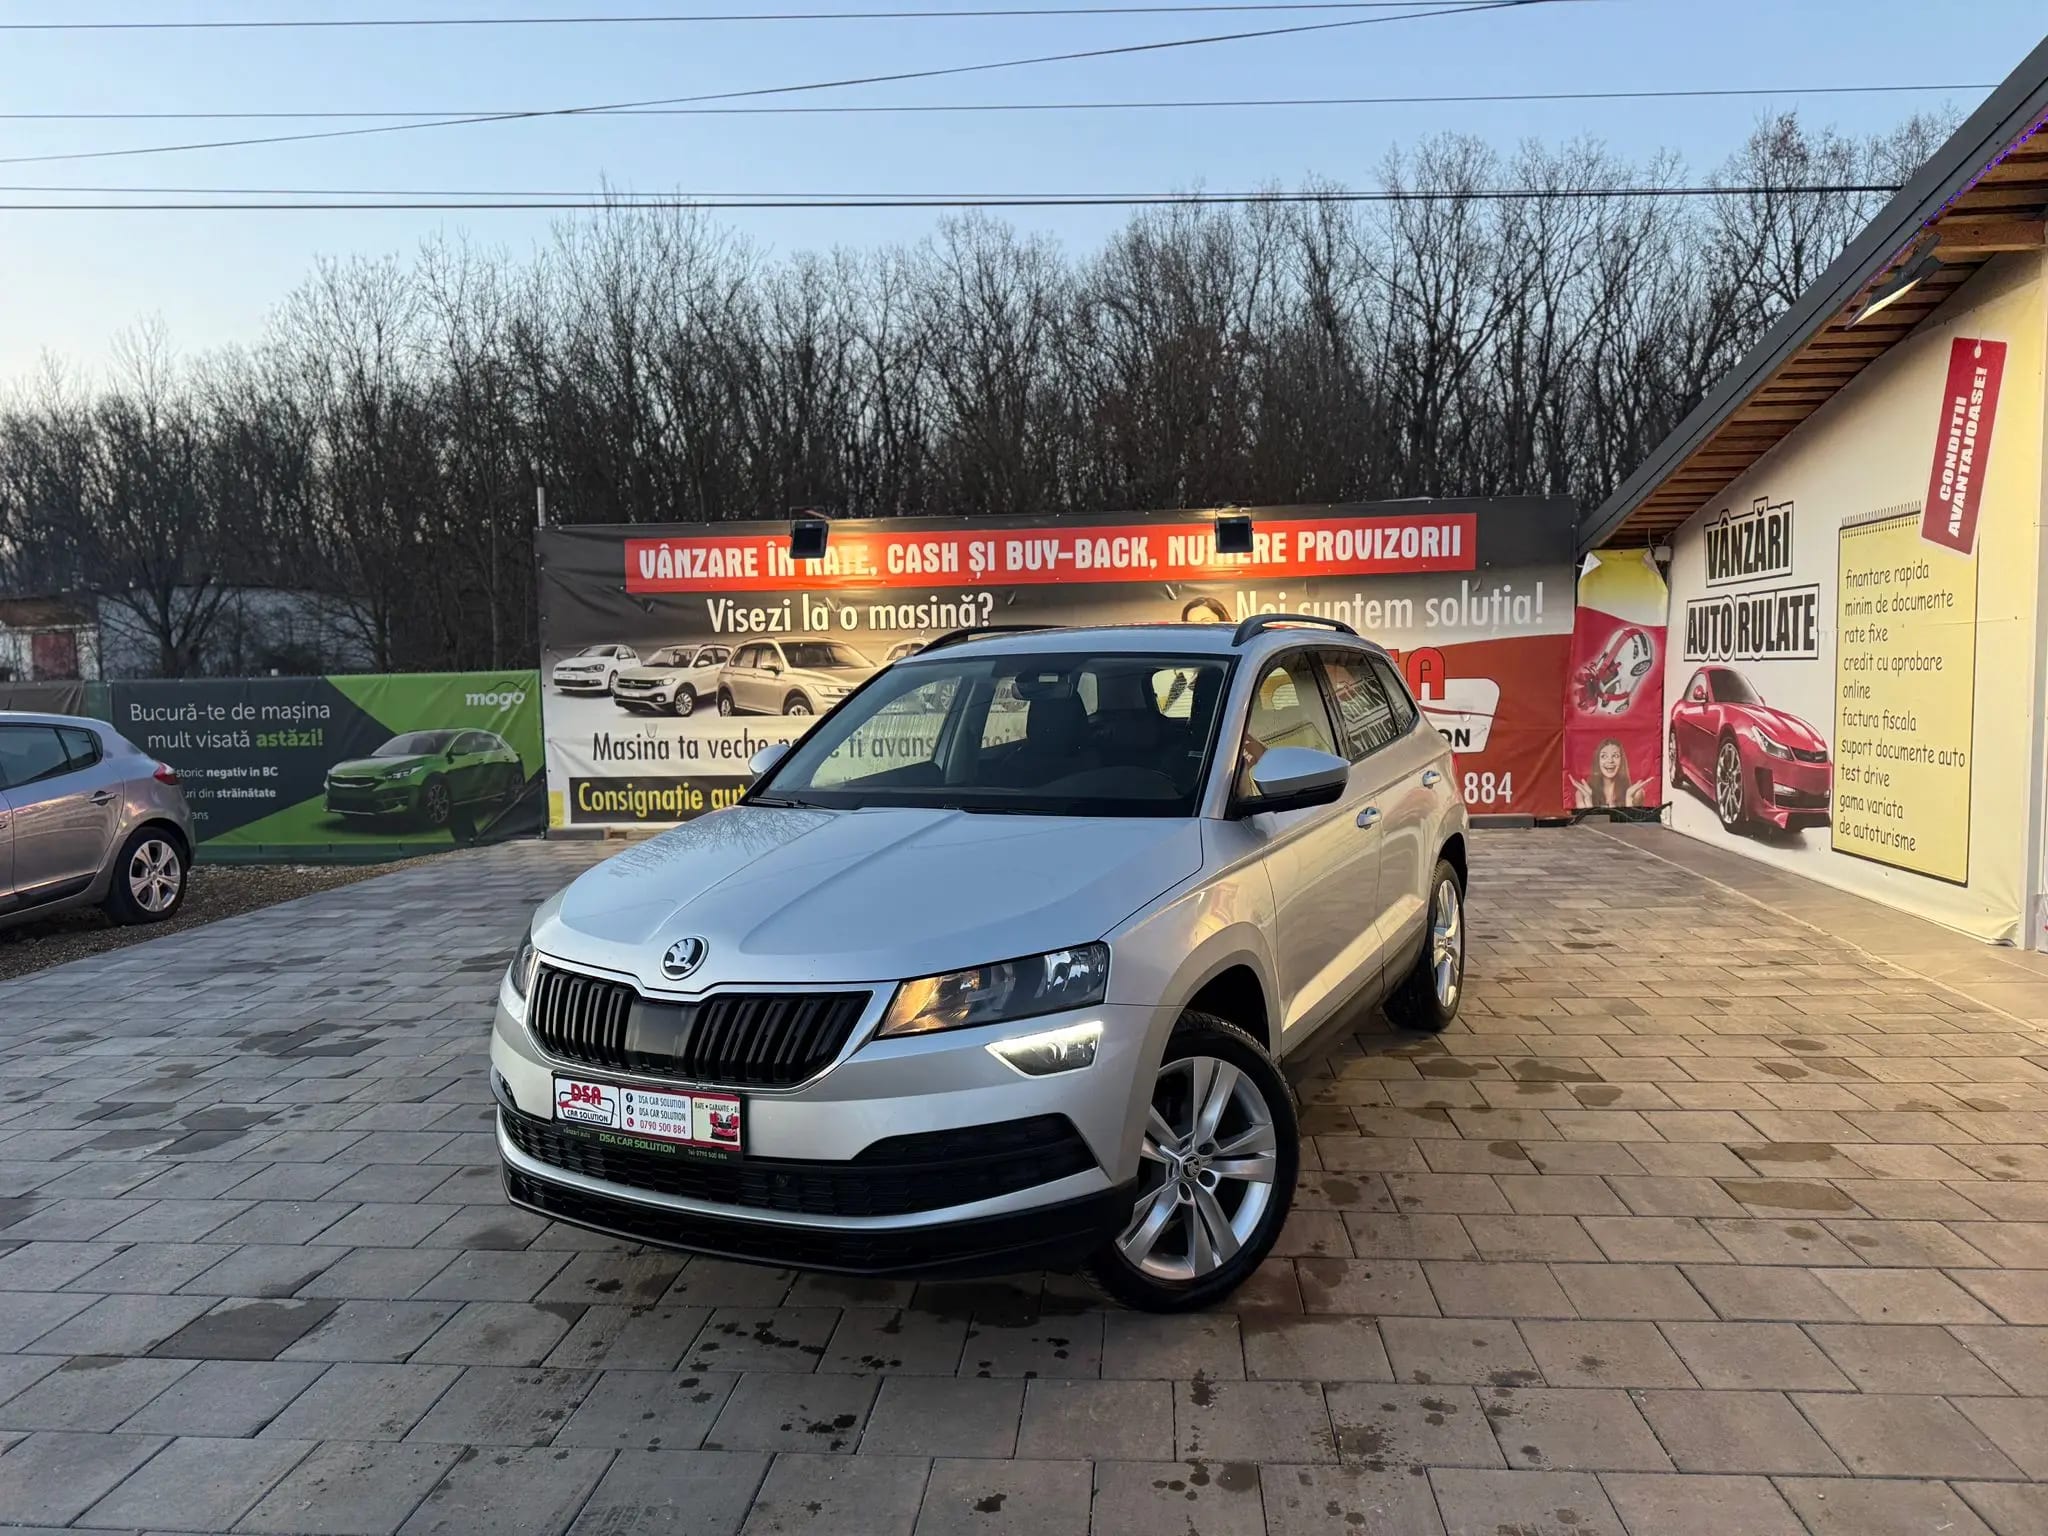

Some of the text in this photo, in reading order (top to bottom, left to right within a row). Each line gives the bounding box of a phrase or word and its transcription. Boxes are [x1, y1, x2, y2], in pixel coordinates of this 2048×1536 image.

[1939, 396, 1967, 501] CONDITII
[1948, 367, 1988, 538] AVANTAJOASE!
[639, 543, 759, 579] VÂNZARE
[887, 542, 958, 574] CASH
[968, 541, 995, 579] ȘI
[1006, 536, 1158, 571] BUY-BACK,
[1298, 525, 1461, 562] PROVIZORII
[1707, 505, 1790, 580] VÂNZĂRI
[1846, 558, 1929, 589] finantare rapida
[706, 598, 791, 633] Visezi
[802, 593, 829, 632] la
[840, 605, 858, 631] o
[1845, 589, 1954, 616] minim de documente
[1687, 594, 1816, 655] AUTO RULATE
[1845, 623, 1889, 643] rate fixe
[1843, 650, 1943, 677] credit cu aprobare
[464, 691, 526, 712] mogo
[1843, 680, 1871, 699] online
[130, 702, 330, 724] Bucură-te de mașina
[1842, 707, 1917, 731] factura fiscala
[148, 728, 324, 748] mult visată astăzi!
[678, 735, 699, 760] ta
[1841, 737, 1966, 767] suport documente auto
[207, 767, 248, 779] negativ
[263, 766, 279, 776] BC
[1841, 764, 1890, 787] test drive
[199, 788, 214, 798] din
[578, 782, 746, 817] Consignație aut
[1464, 771, 1512, 804] 884
[1840, 794, 1904, 819] gama variata
[1840, 816, 1916, 851] de autoturisme
[570, 1083, 602, 1105] DSA
[638, 1095, 686, 1109] DSA CAR SOLUTION
[567, 1109, 608, 1122] CAR SOLUTION
[639, 1107, 686, 1121] DSA CAR SOLUTION
[640, 1120, 686, 1134] 0790 500 884
[600, 1133, 676, 1153] DSA CAR SOLUTION
